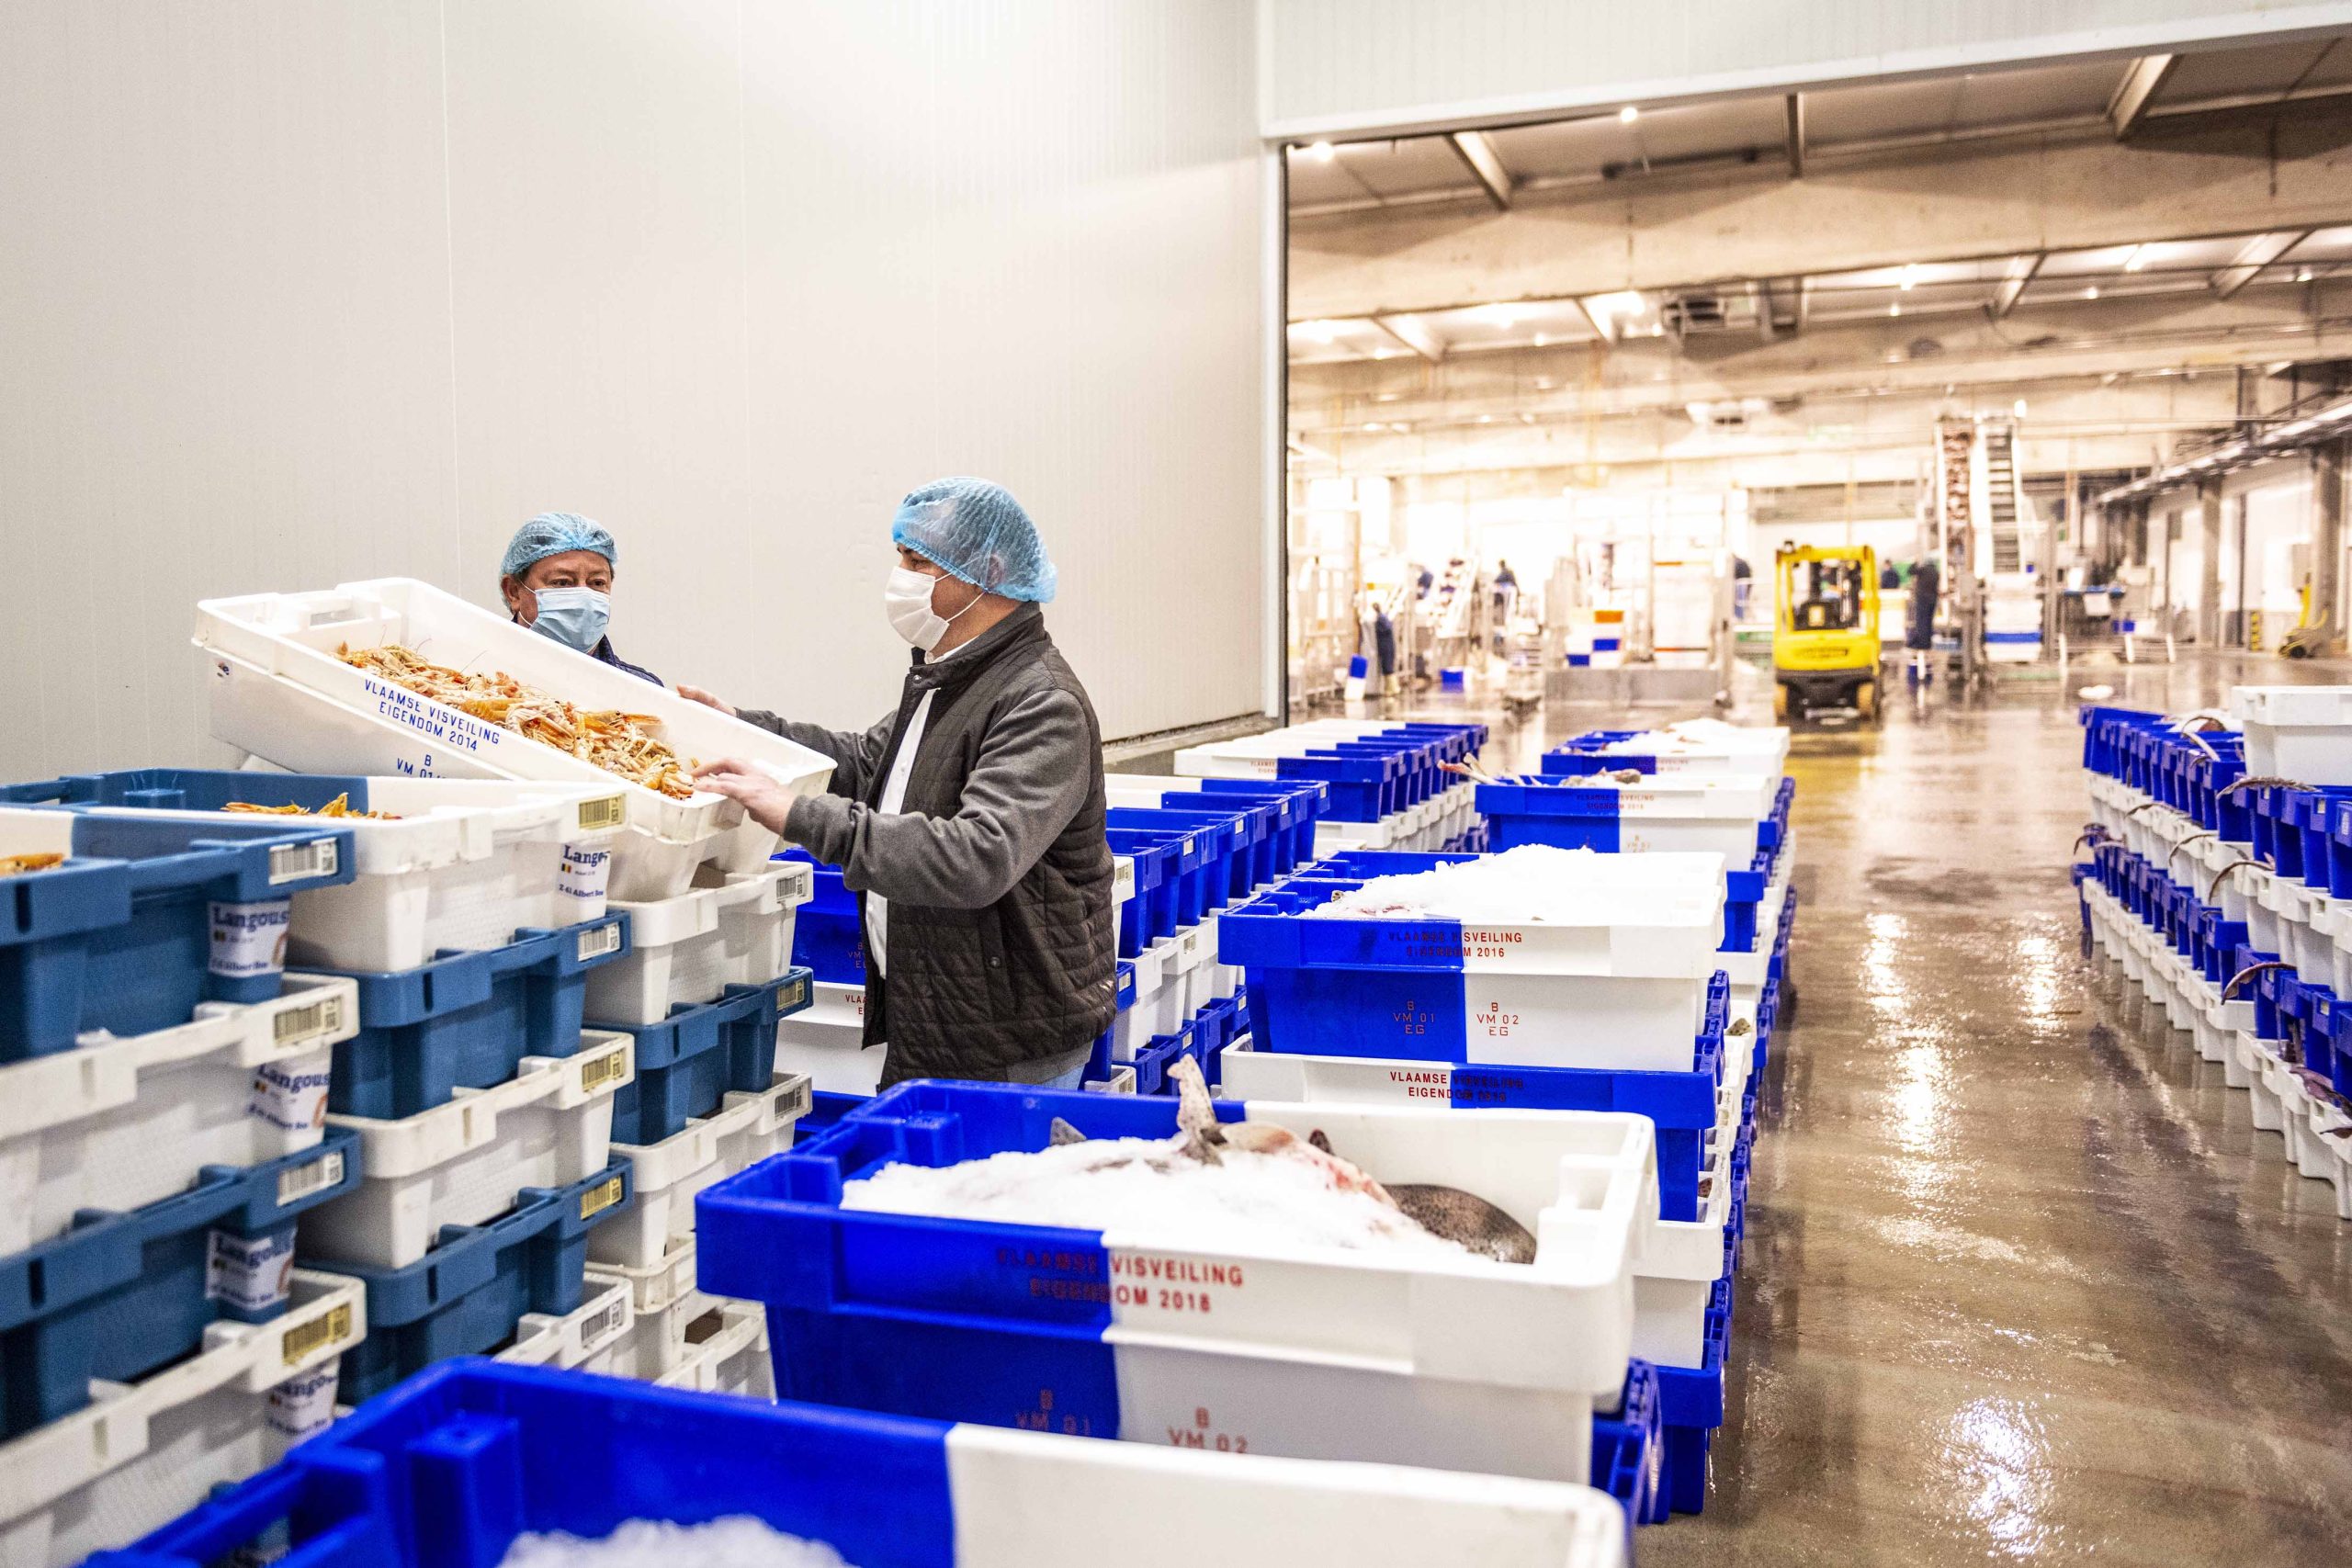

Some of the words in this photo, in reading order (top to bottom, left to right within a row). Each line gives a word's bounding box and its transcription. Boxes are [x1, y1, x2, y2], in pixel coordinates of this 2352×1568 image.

[365, 679, 421, 712] VLAAMSE
[429, 706, 500, 745] VISVEILING
[379, 701, 443, 738] EIGENDOM
[449, 730, 478, 751] 2014
[397, 757, 413, 775] VM
[424, 754, 432, 767] B
[1452, 931, 1523, 943] VISVEILING
[1476, 947, 1505, 958] 2016
[1407, 1000, 1415, 1011] B
[1491, 1002, 1498, 1012] B
[1393, 1012, 1412, 1022] VM
[1419, 1013, 1435, 1023] 01
[1476, 1014, 1496, 1024] VM
[1502, 1014, 1519, 1025] 02
[1405, 1024, 1425, 1034] EG
[1488, 1026, 1509, 1036] EG
[1390, 1071, 1447, 1084] VLAAMSE
[1408, 1087, 1475, 1100] EIGENDOM
[1110, 1255, 1245, 1288] VISVEILING
[1195, 1406, 1210, 1429] B
[1167, 1426, 1205, 1450] VM
[1216, 1432, 1249, 1454] 02
